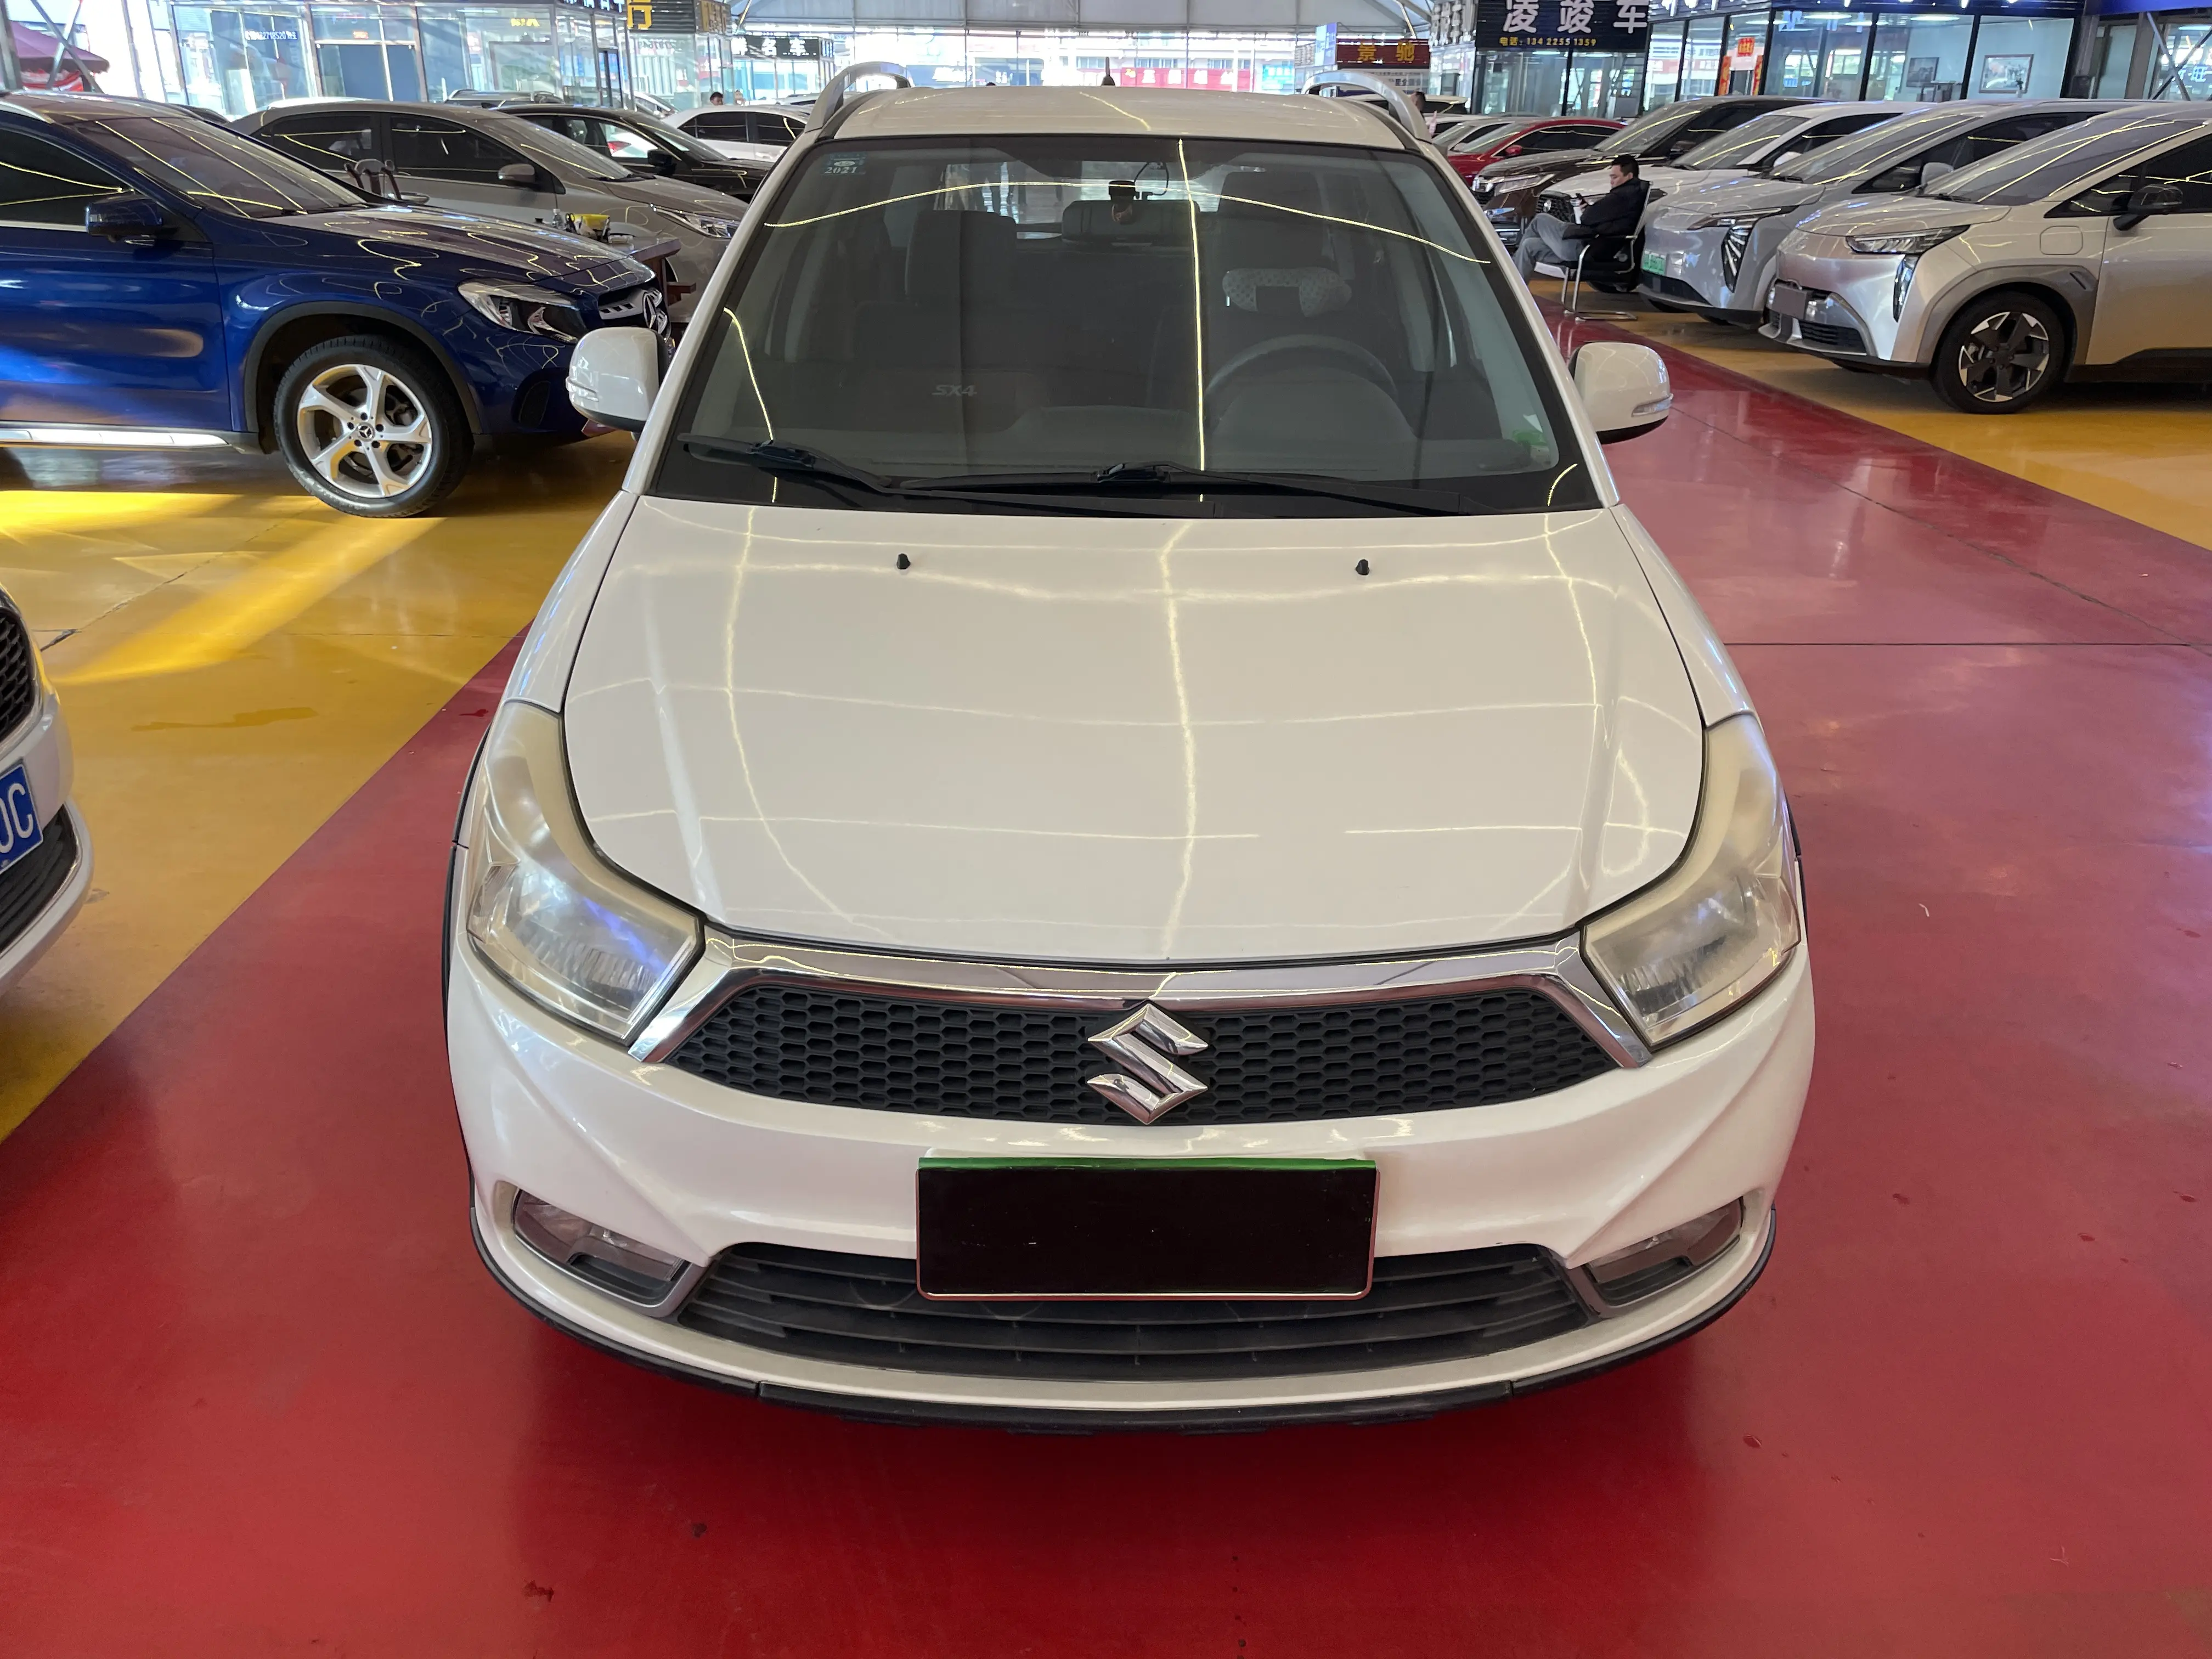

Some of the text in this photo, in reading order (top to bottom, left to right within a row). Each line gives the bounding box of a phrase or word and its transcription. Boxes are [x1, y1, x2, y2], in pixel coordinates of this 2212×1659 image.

[1527, 37, 1543, 45] 134
[1573, 38, 1596, 46] 1359
[932, 385, 977, 396] SX4
